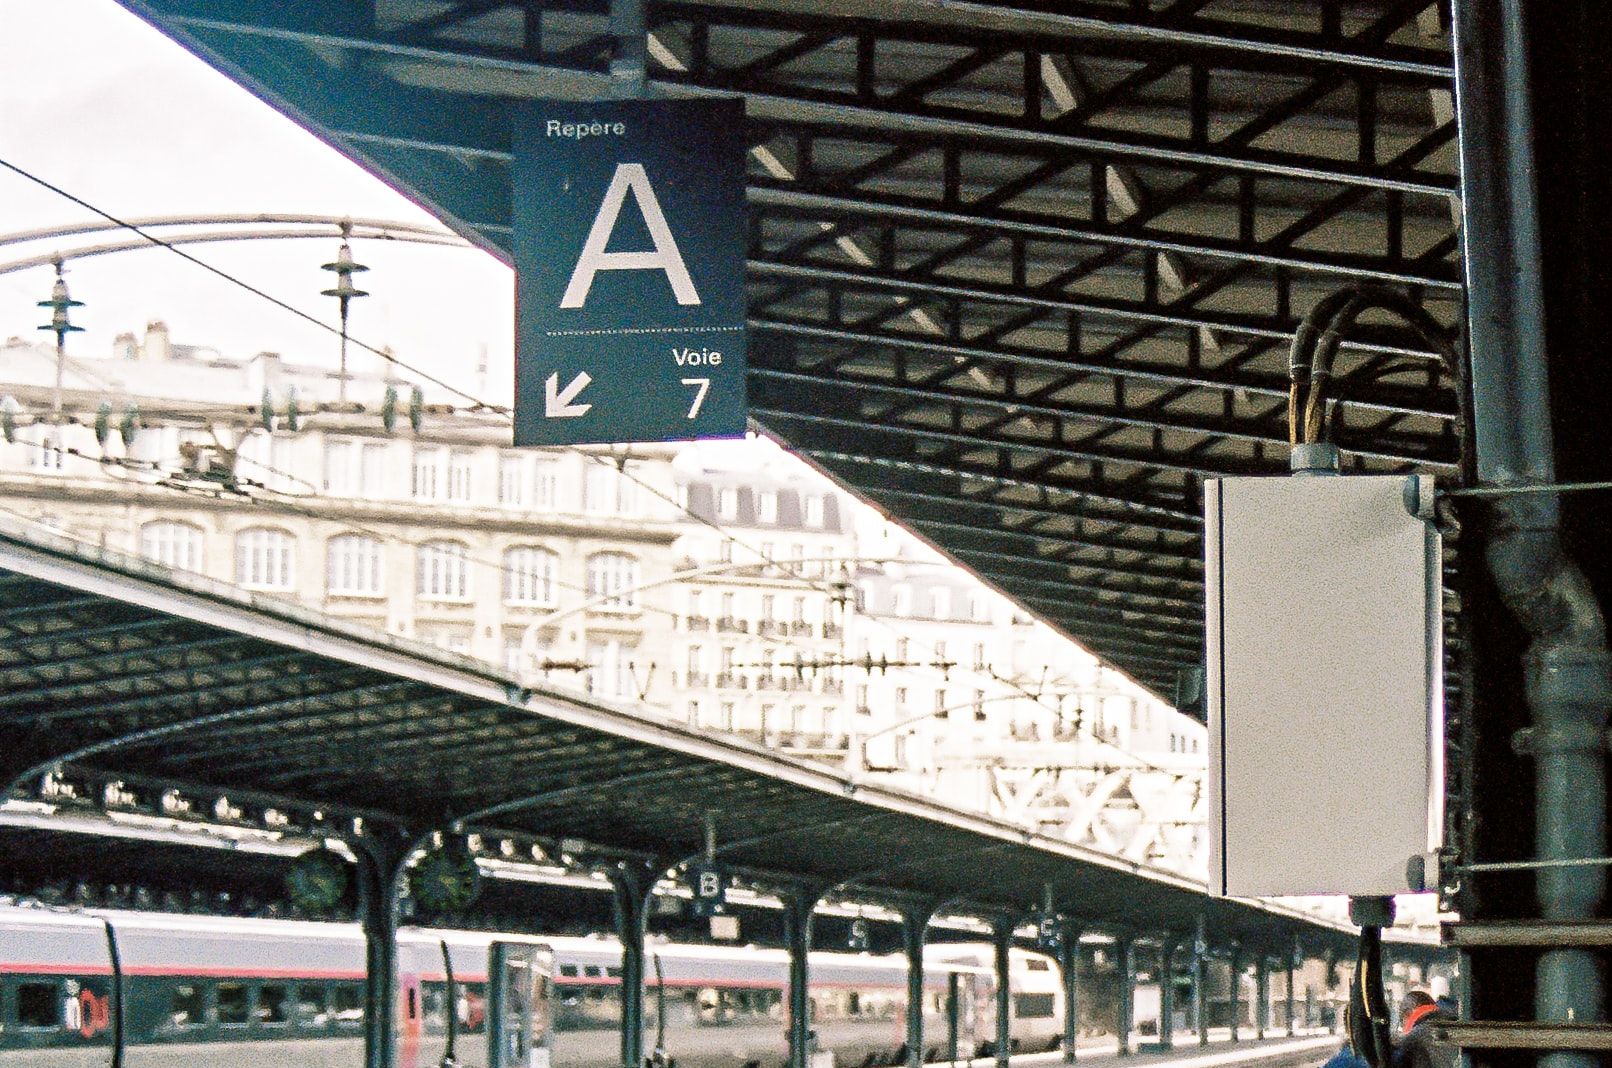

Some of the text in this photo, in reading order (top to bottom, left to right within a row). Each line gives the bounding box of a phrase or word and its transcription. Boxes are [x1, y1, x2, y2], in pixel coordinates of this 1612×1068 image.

[546, 119, 626, 140] Repère
[560, 162, 702, 308] A
[672, 348, 723, 367] Voie
[681, 377, 710, 419] 7
[700, 871, 719, 897] B
